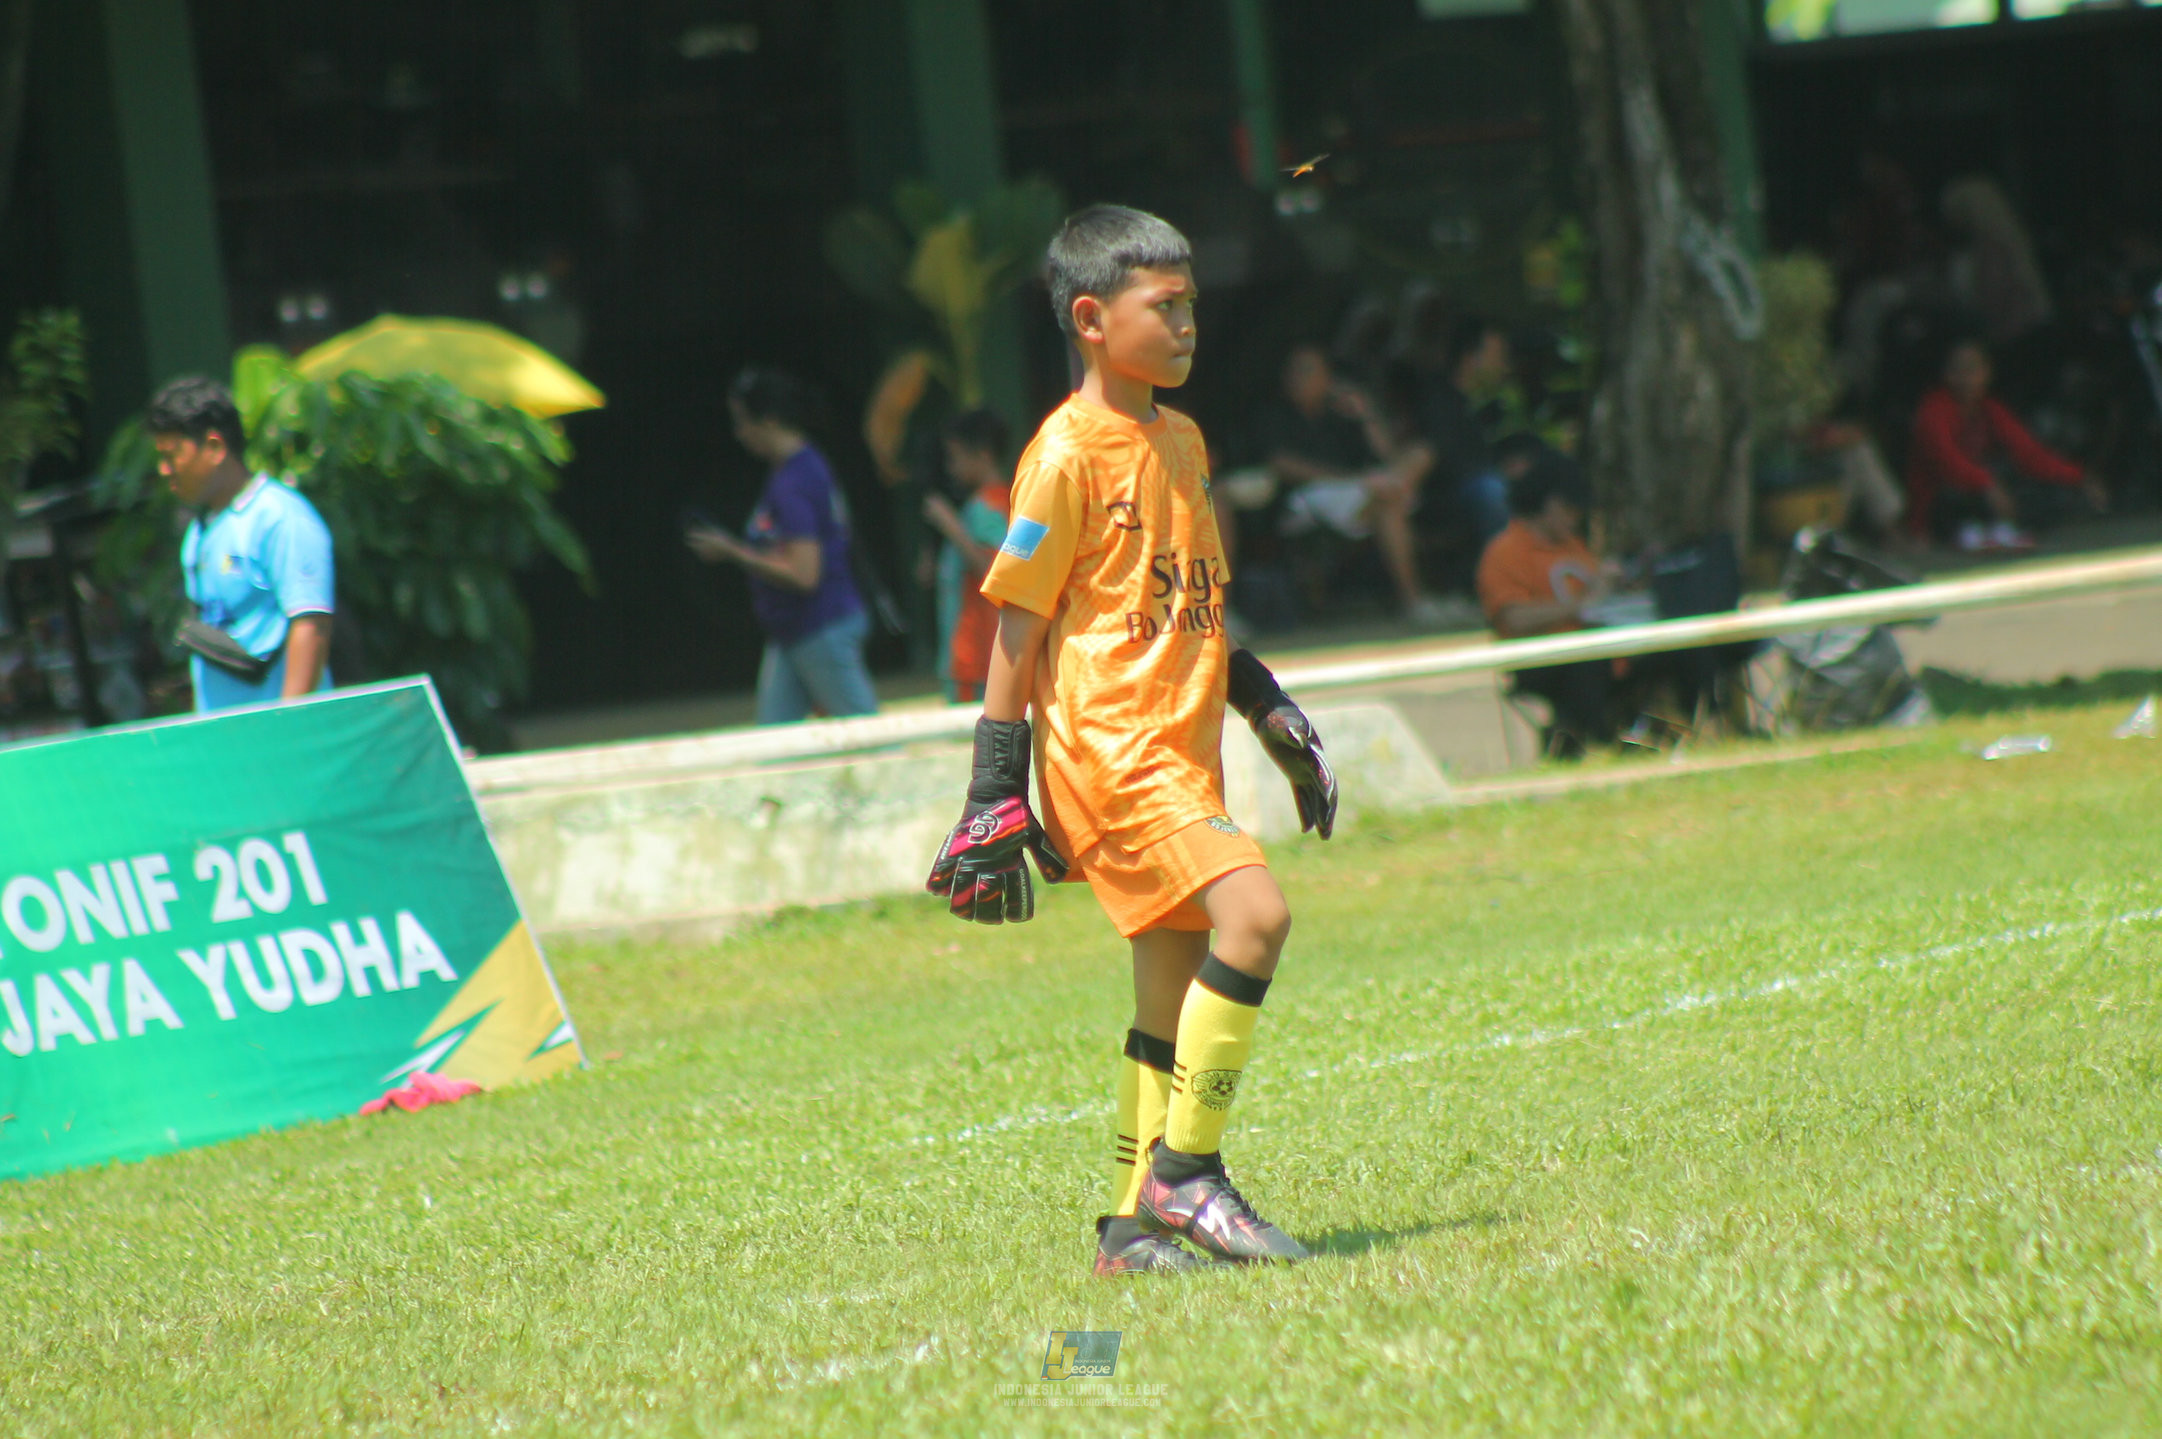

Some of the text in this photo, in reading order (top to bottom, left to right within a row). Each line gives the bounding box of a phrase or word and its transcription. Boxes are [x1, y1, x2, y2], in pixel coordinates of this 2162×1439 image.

[0, 830, 328, 959] ONIF 201
[0, 910, 458, 1057] JAYA YUDHA
